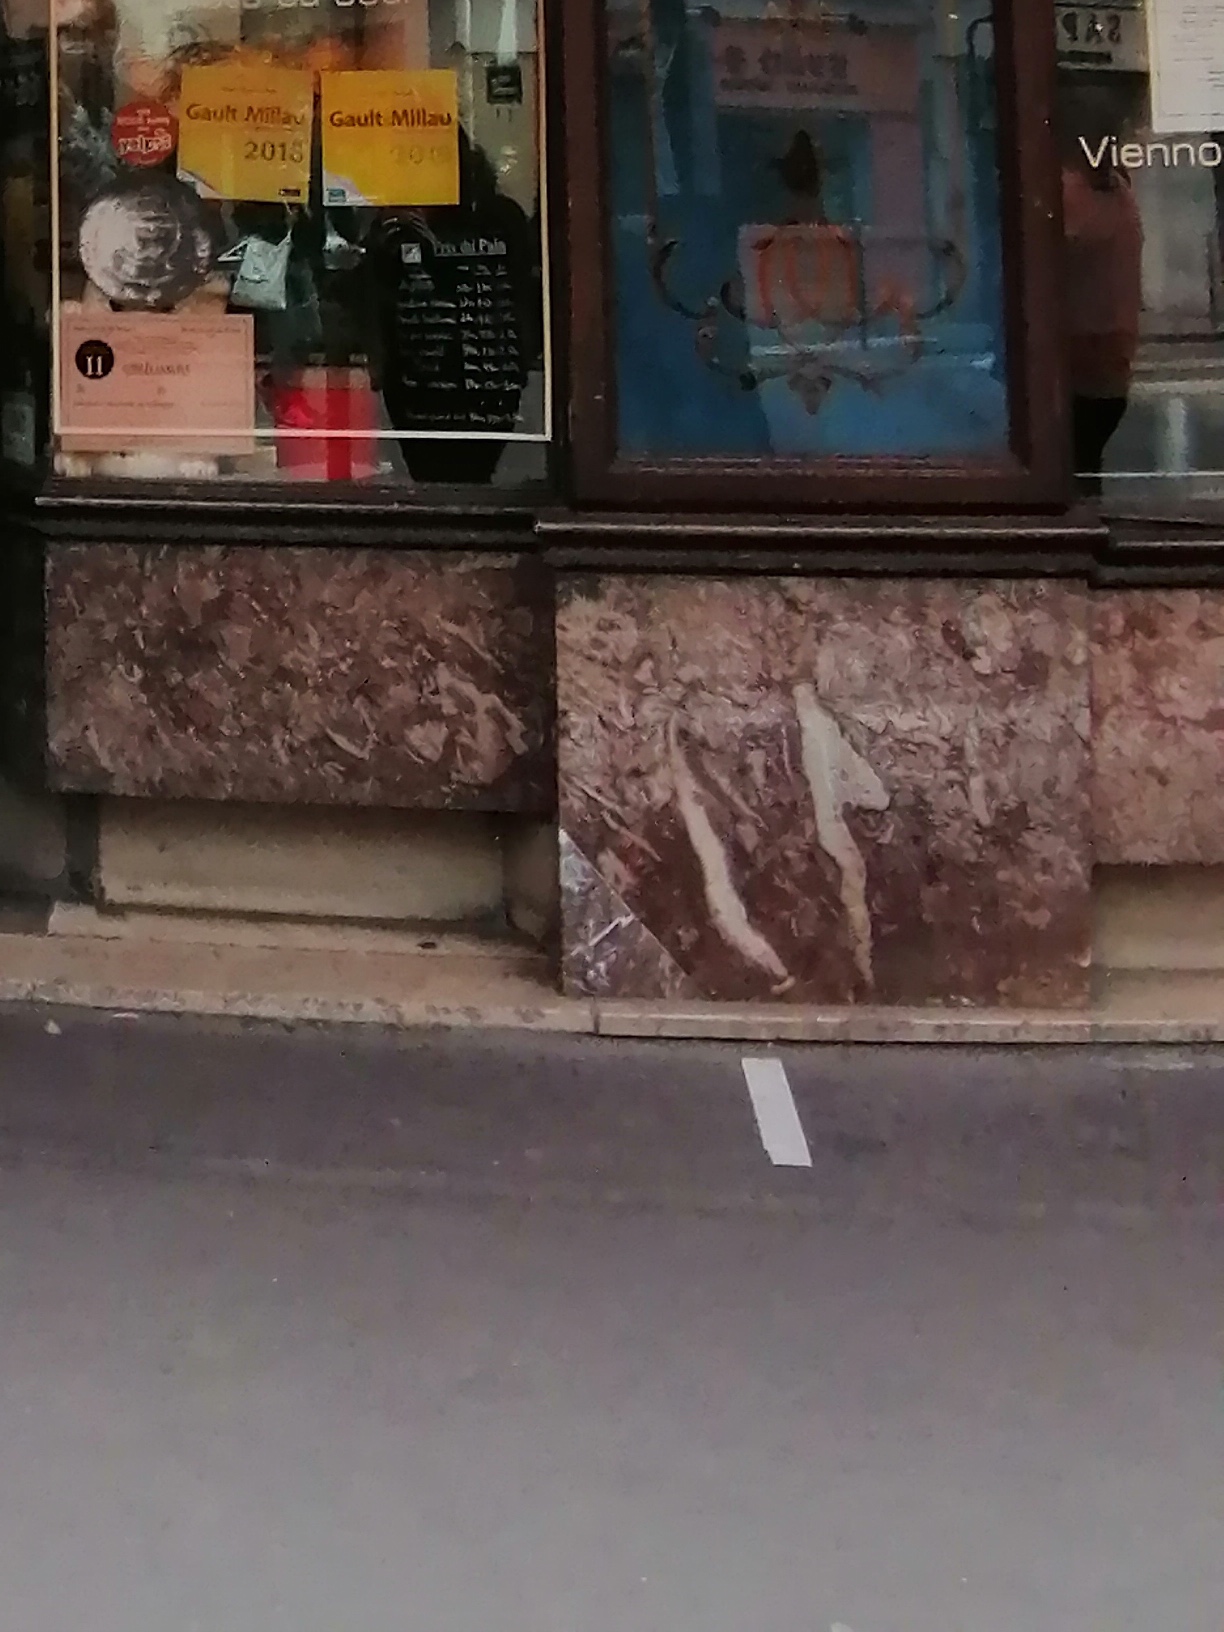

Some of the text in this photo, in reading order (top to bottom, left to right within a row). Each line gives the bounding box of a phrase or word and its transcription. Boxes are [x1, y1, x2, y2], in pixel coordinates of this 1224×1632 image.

[186, 103, 238, 123] Gault
[329, 108, 453, 128] Gault Millau
[1077, 134, 1223, 170] Vienno
